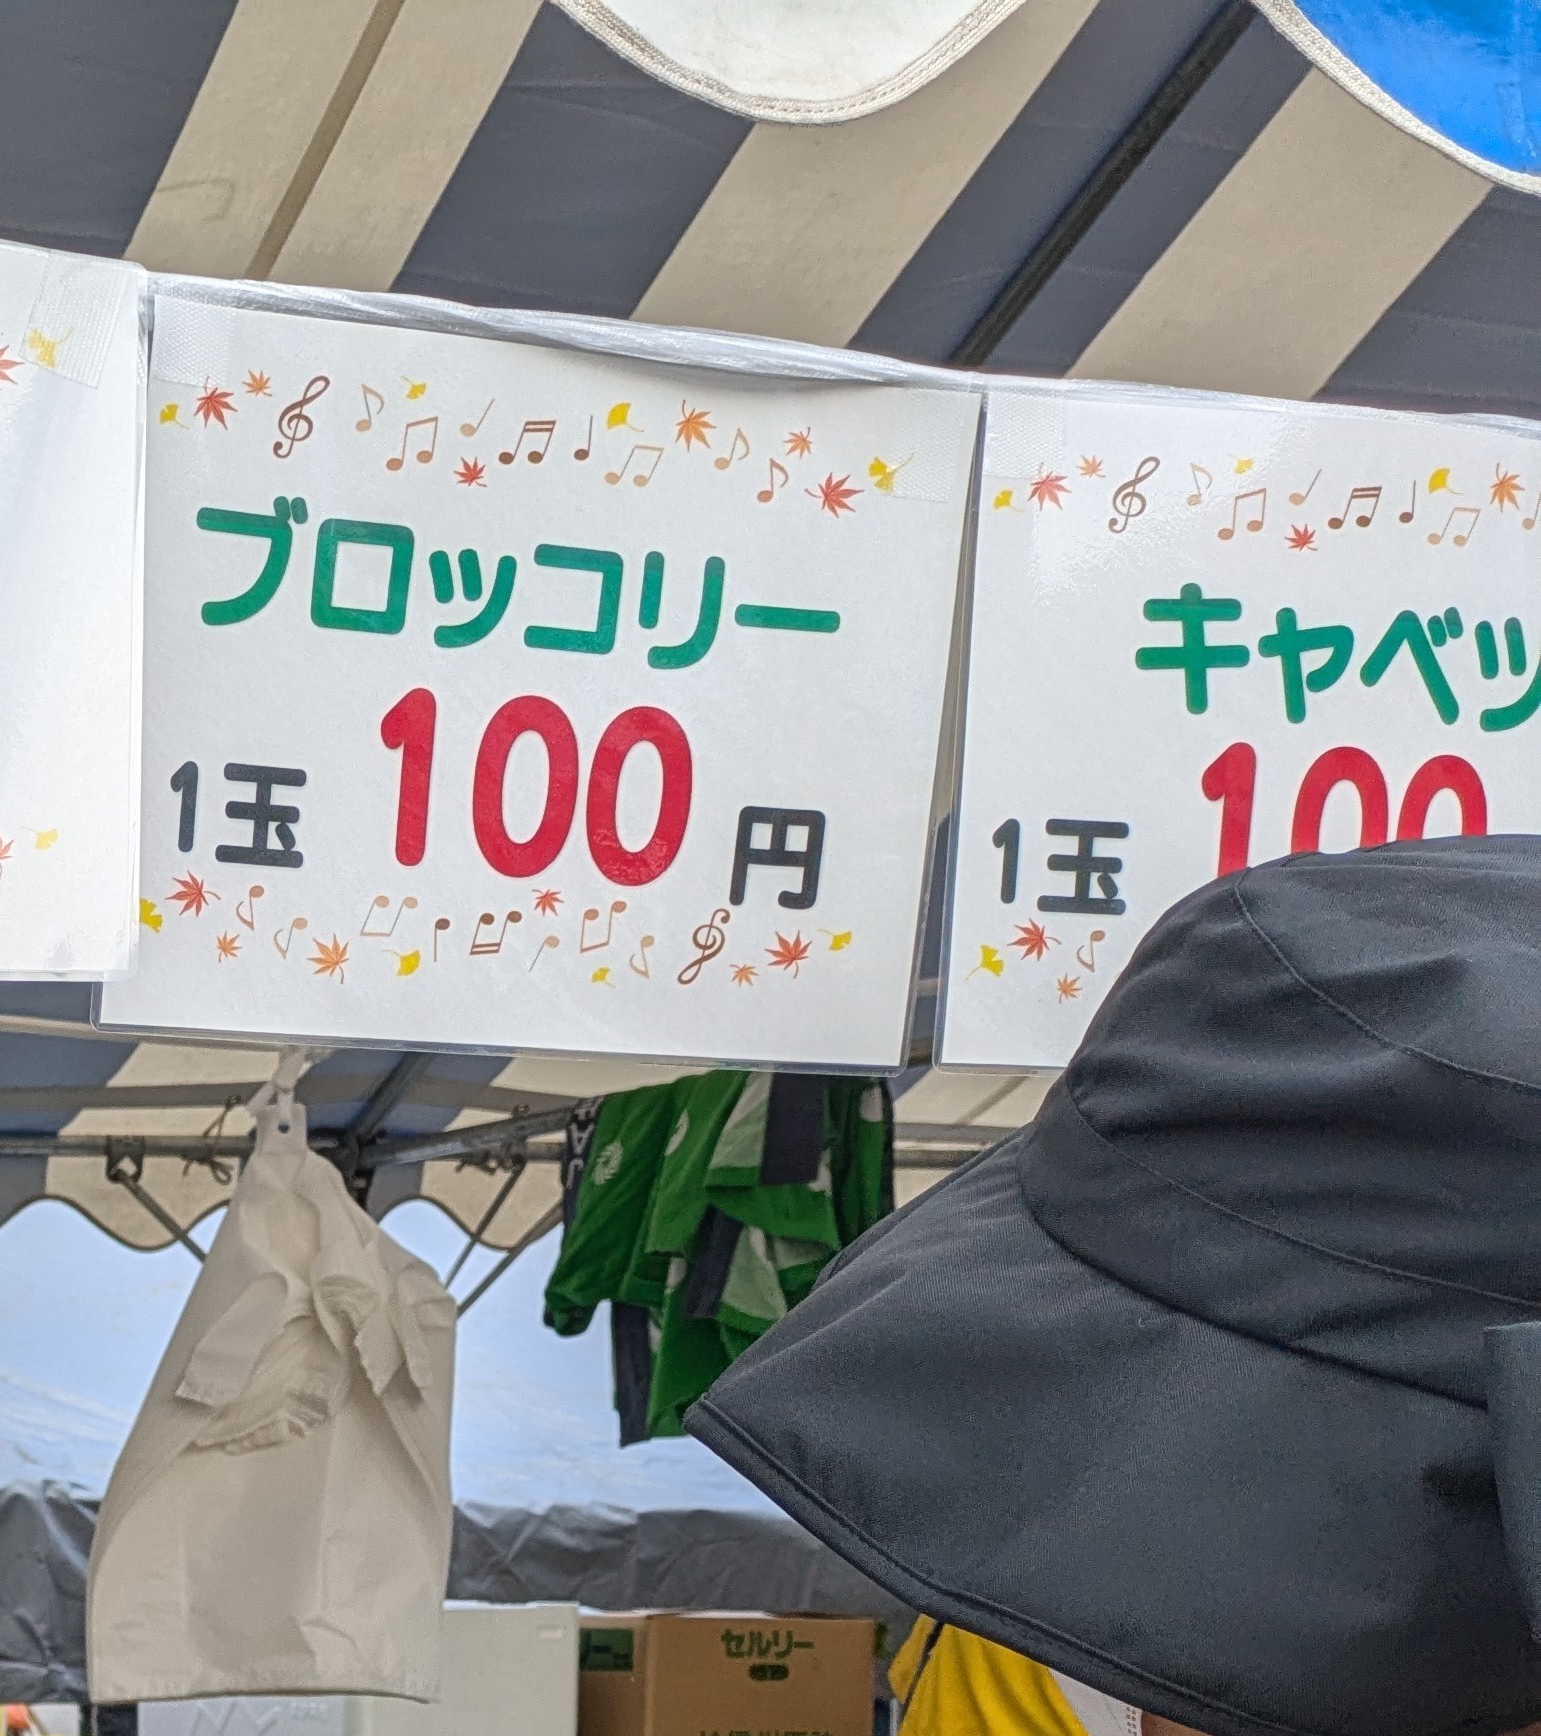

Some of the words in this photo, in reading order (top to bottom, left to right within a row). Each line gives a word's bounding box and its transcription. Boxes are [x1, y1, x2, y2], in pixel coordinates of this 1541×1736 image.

[196, 495, 842, 671] ブロッコリー
[169, 760, 305, 870] 1玉
[379, 686, 694, 888] 100
[729, 804, 827, 911] 円
[991, 817, 1131, 918] 1玉
[720, 1627, 815, 1660] セルリー
